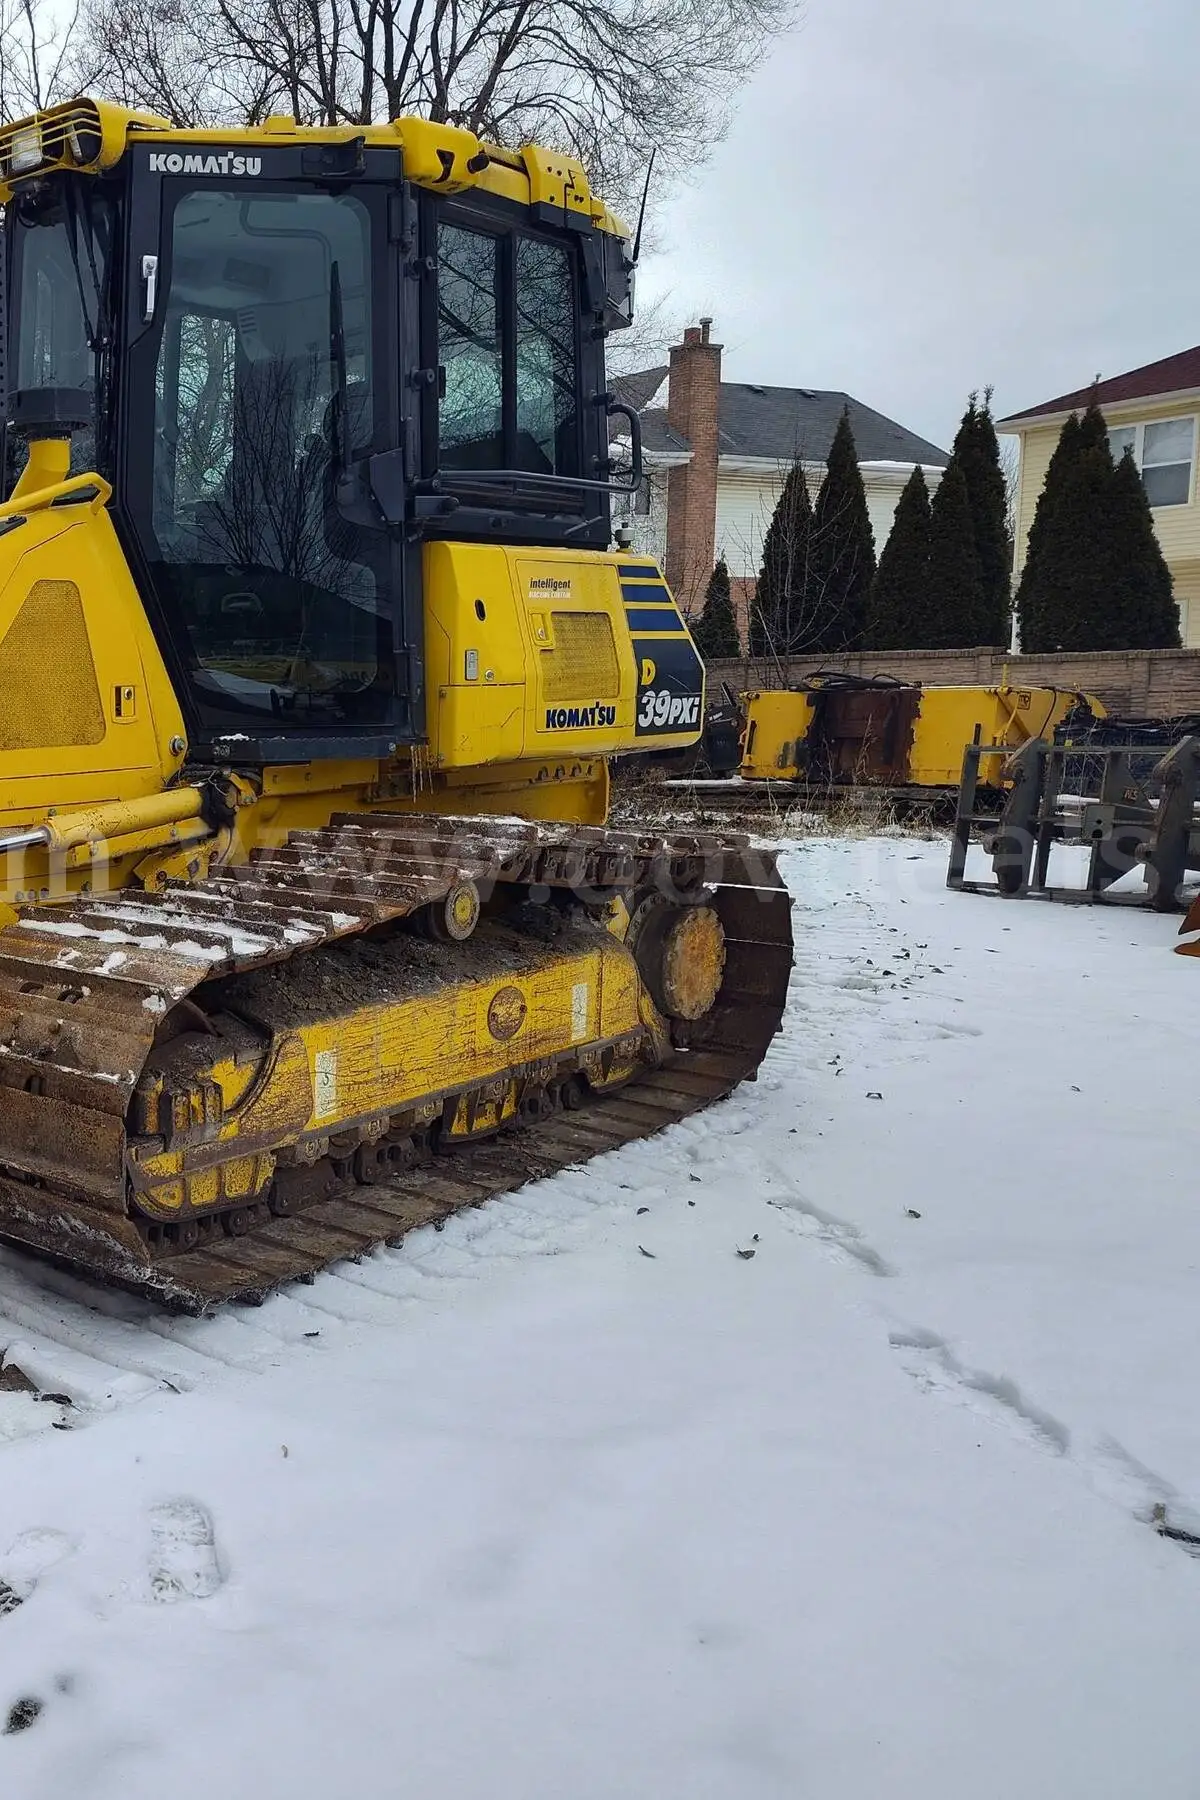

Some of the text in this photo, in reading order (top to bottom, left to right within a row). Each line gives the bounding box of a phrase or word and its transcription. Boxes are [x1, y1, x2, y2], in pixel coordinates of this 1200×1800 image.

[149, 151, 262, 176] KOMATSU
[529, 576, 571, 591] intelligent
[640, 658, 656, 686] D
[546, 701, 616, 728] KOMATSU
[638, 690, 700, 728] 39PXi
